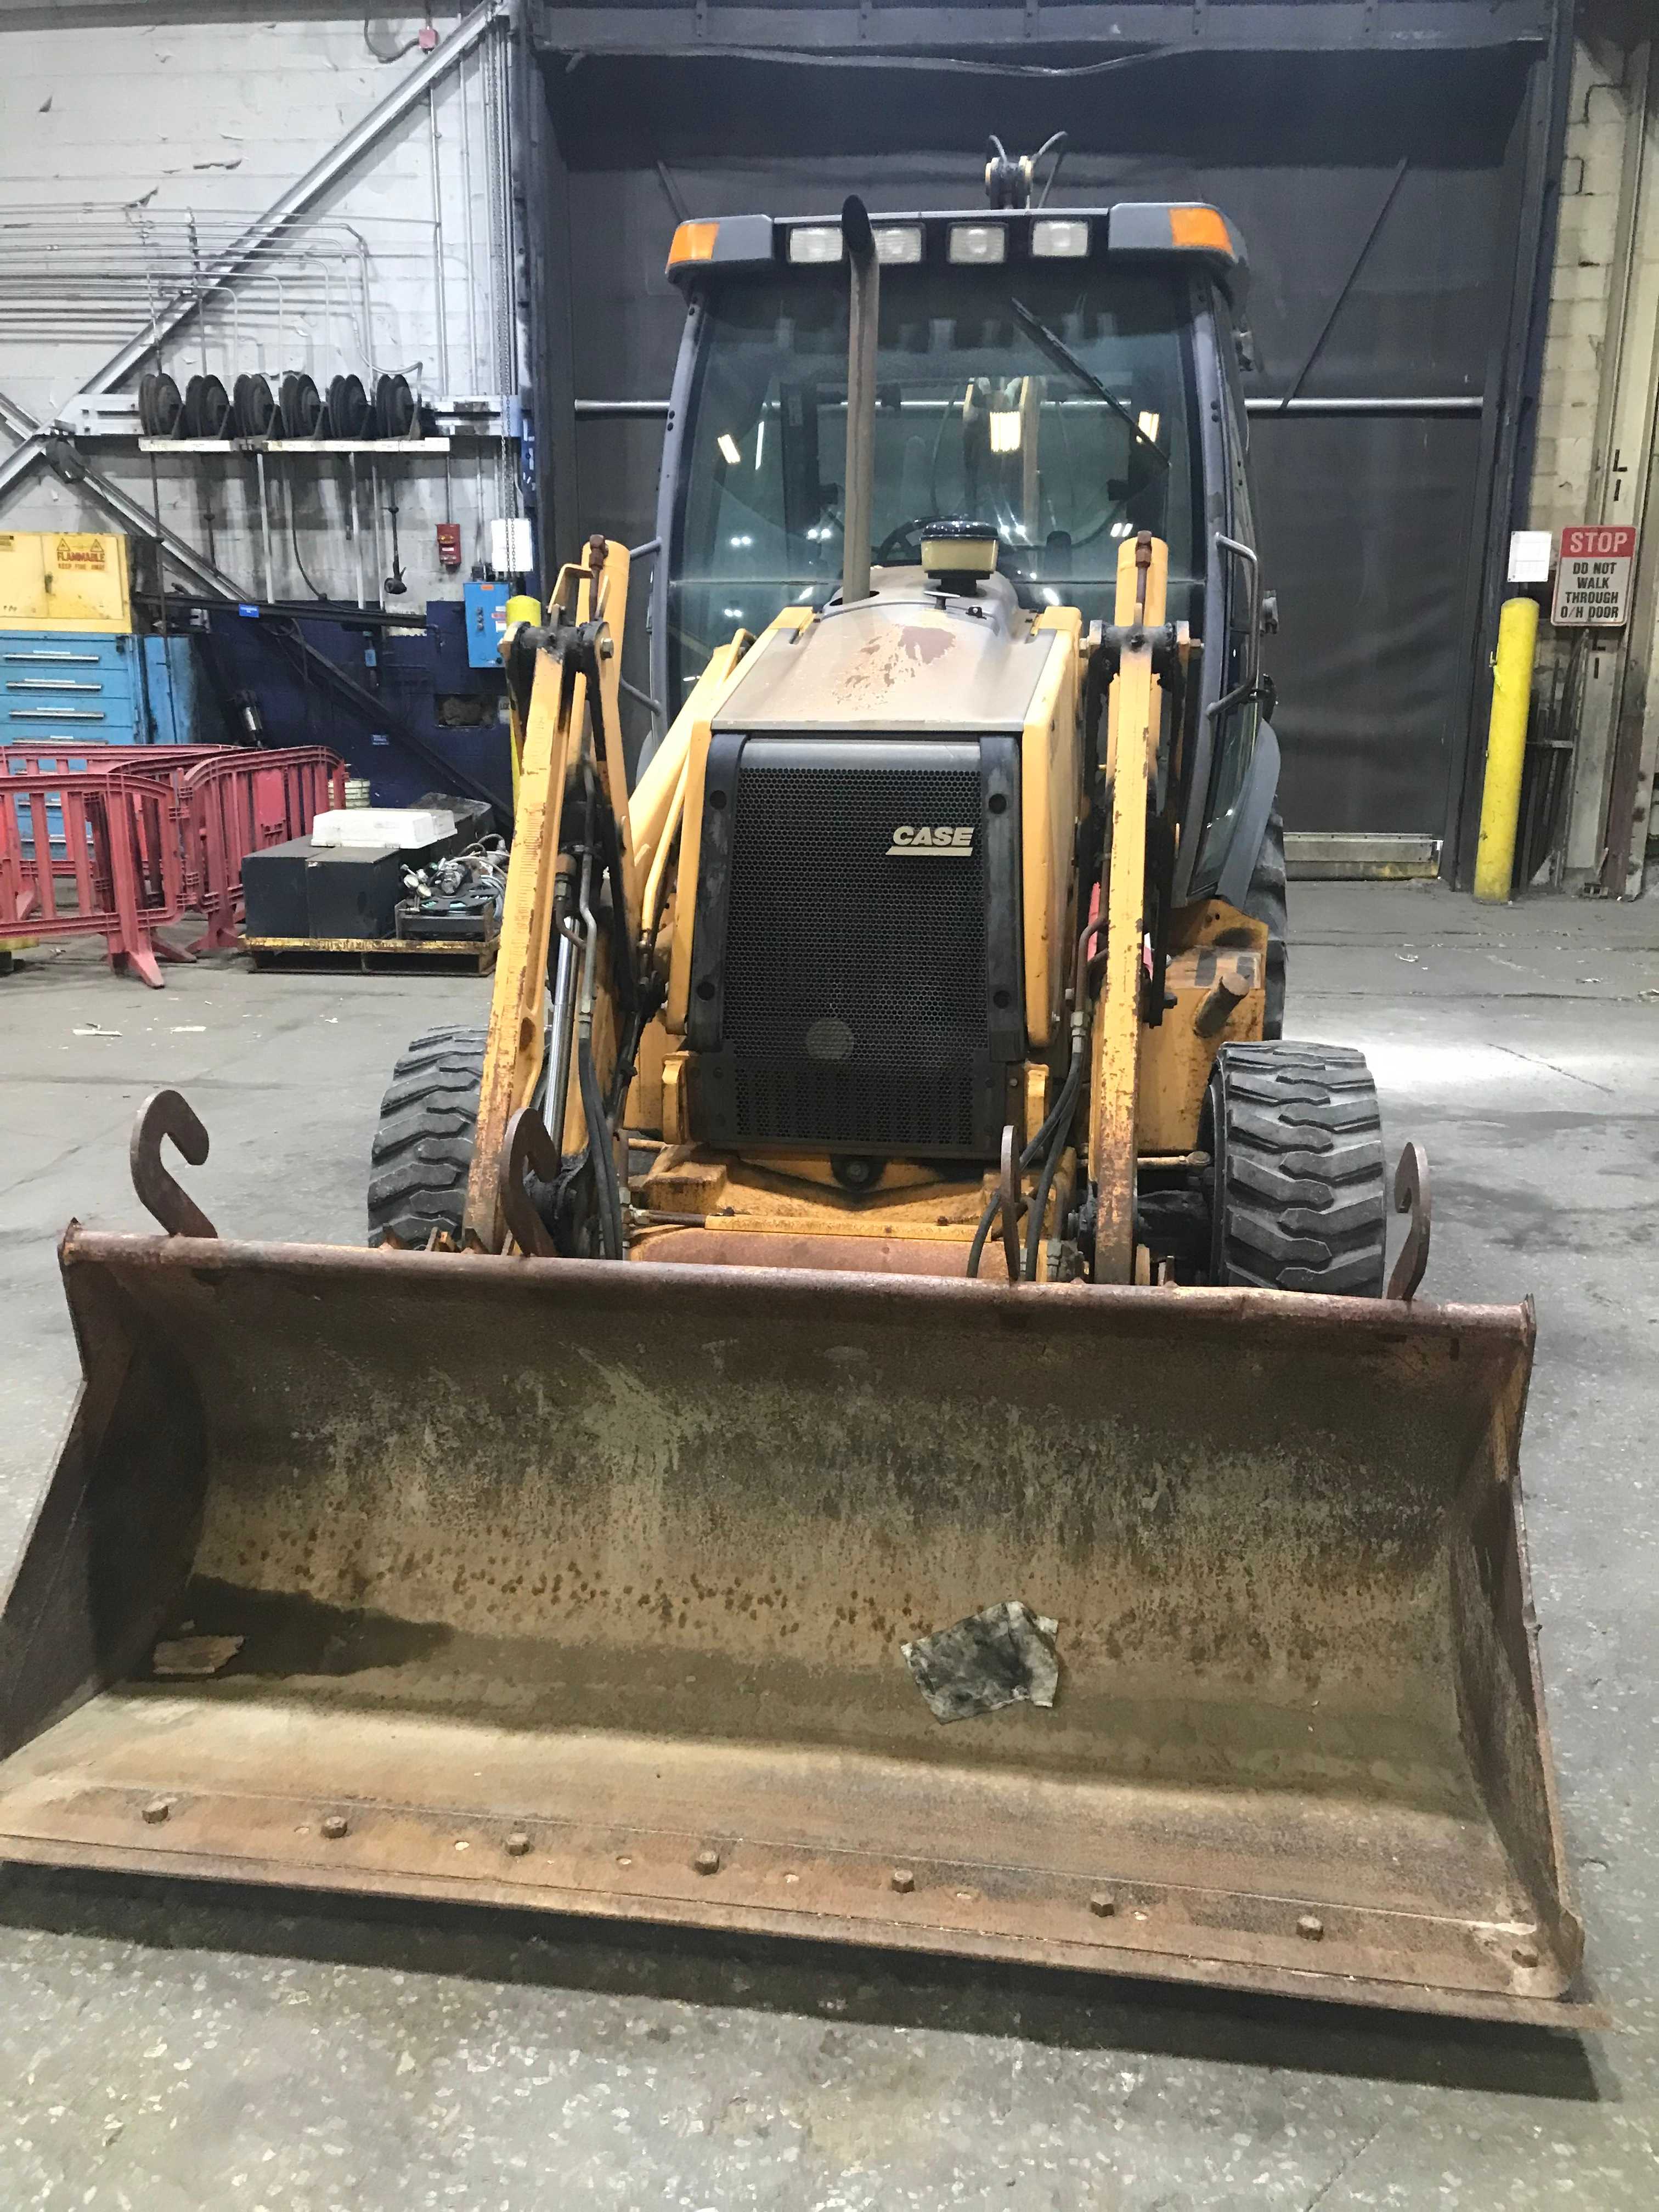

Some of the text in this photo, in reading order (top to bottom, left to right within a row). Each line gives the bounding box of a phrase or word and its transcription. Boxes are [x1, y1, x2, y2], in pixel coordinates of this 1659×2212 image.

[1570, 532, 1628, 553] STOP
[57, 551, 105, 562] FLAMMABLE
[1572, 562, 1617, 574] DO NOT
[1577, 577, 1609, 589] WALK
[1565, 591, 1618, 603] THROUGH
[1560, 606, 1618, 618] O/H DOOR
[893, 826, 974, 846] CASE
